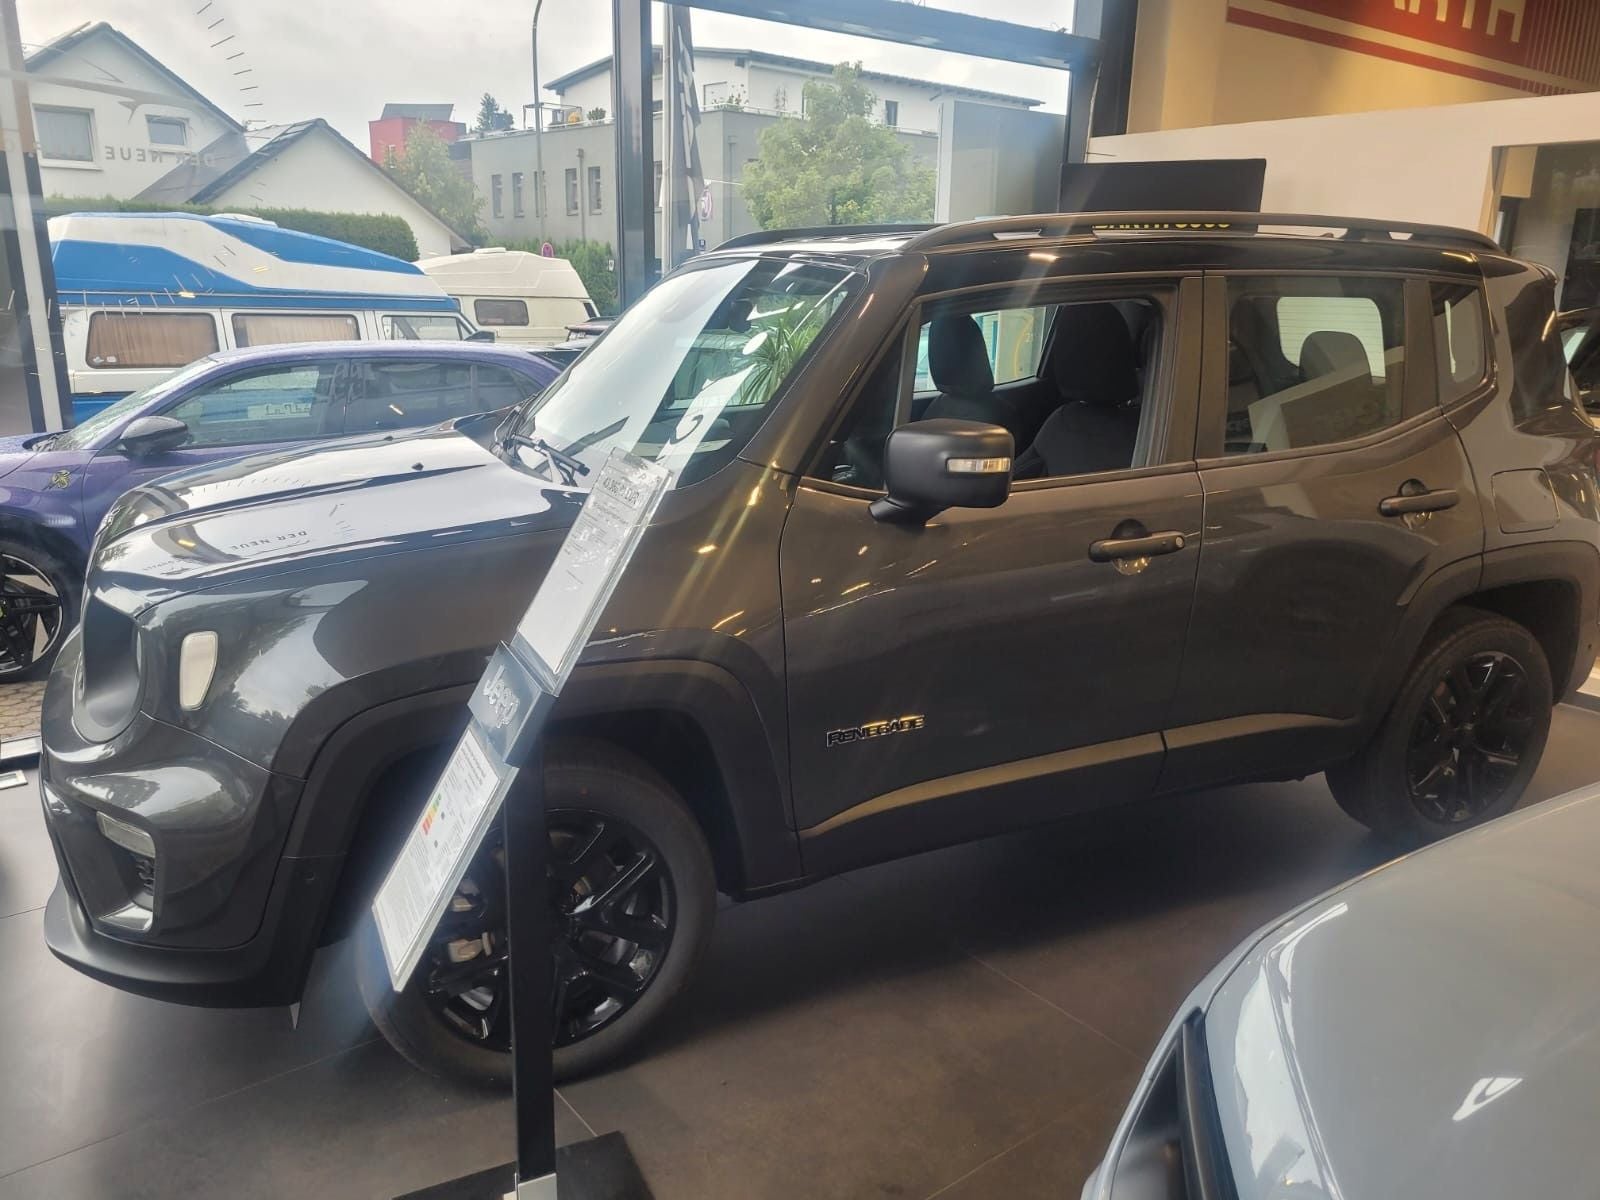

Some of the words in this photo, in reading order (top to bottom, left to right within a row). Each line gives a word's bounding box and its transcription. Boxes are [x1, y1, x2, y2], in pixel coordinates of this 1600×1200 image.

[231, 539, 270, 550] NEUE
[277, 530, 307, 541] DER
[483, 664, 520, 729] Jeep
[826, 714, 925, 748] RENEGADE
